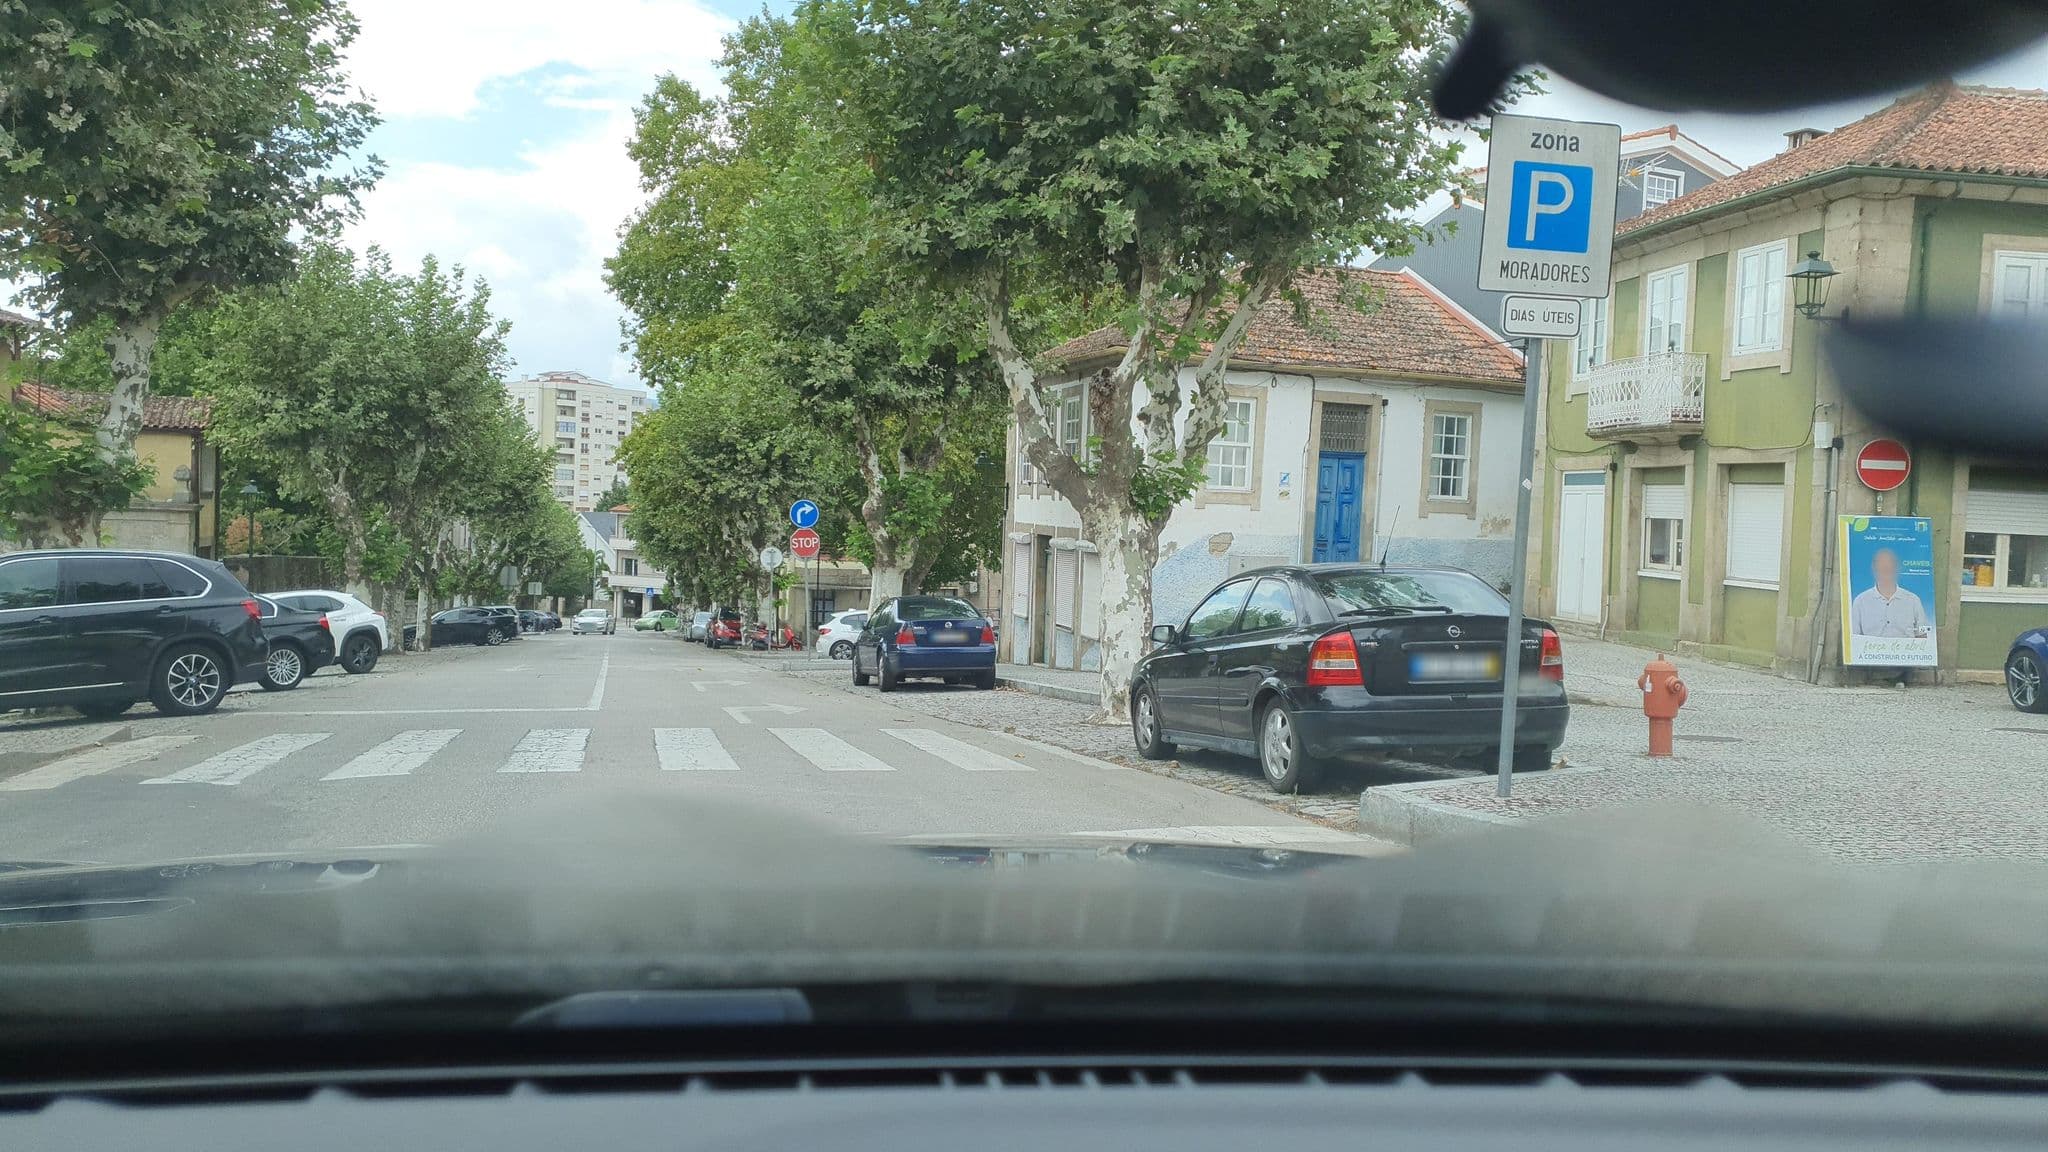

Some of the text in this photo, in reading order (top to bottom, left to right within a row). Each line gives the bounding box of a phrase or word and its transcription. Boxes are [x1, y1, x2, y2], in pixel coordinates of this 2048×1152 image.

[1530, 132, 1580, 152] zona
[1526, 170, 1574, 241] P
[1500, 260, 1591, 284] MORADORES
[1510, 307, 1575, 324] DIAS ÚTEIS
[791, 538, 819, 549] STOP
